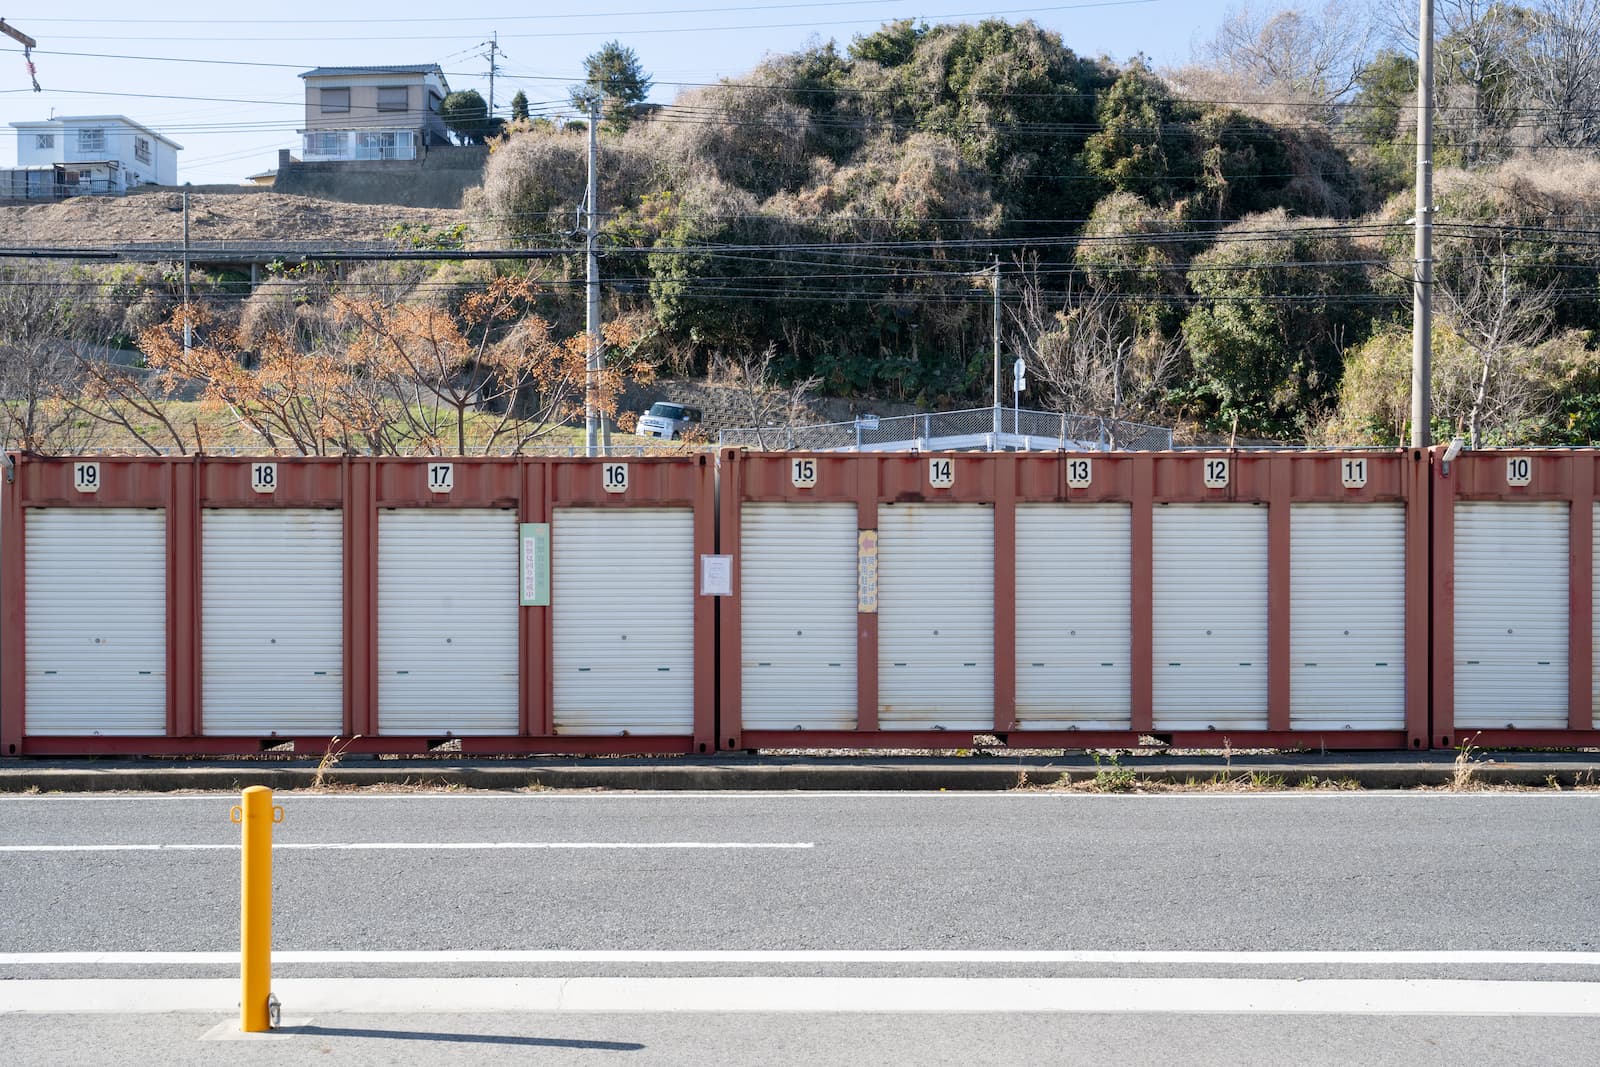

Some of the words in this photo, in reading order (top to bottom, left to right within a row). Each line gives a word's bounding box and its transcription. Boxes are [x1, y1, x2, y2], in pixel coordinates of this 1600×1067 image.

[78, 466, 97, 484] 19
[255, 466, 274, 485] 18
[431, 467, 450, 484] 17
[606, 466, 625, 485] 16
[795, 461, 814, 479] 15
[932, 462, 952, 480] 14
[1070, 462, 1088, 480] 13
[1207, 462, 1226, 480] 12
[1345, 462, 1363, 479] 11
[1509, 460, 1528, 478] 10
